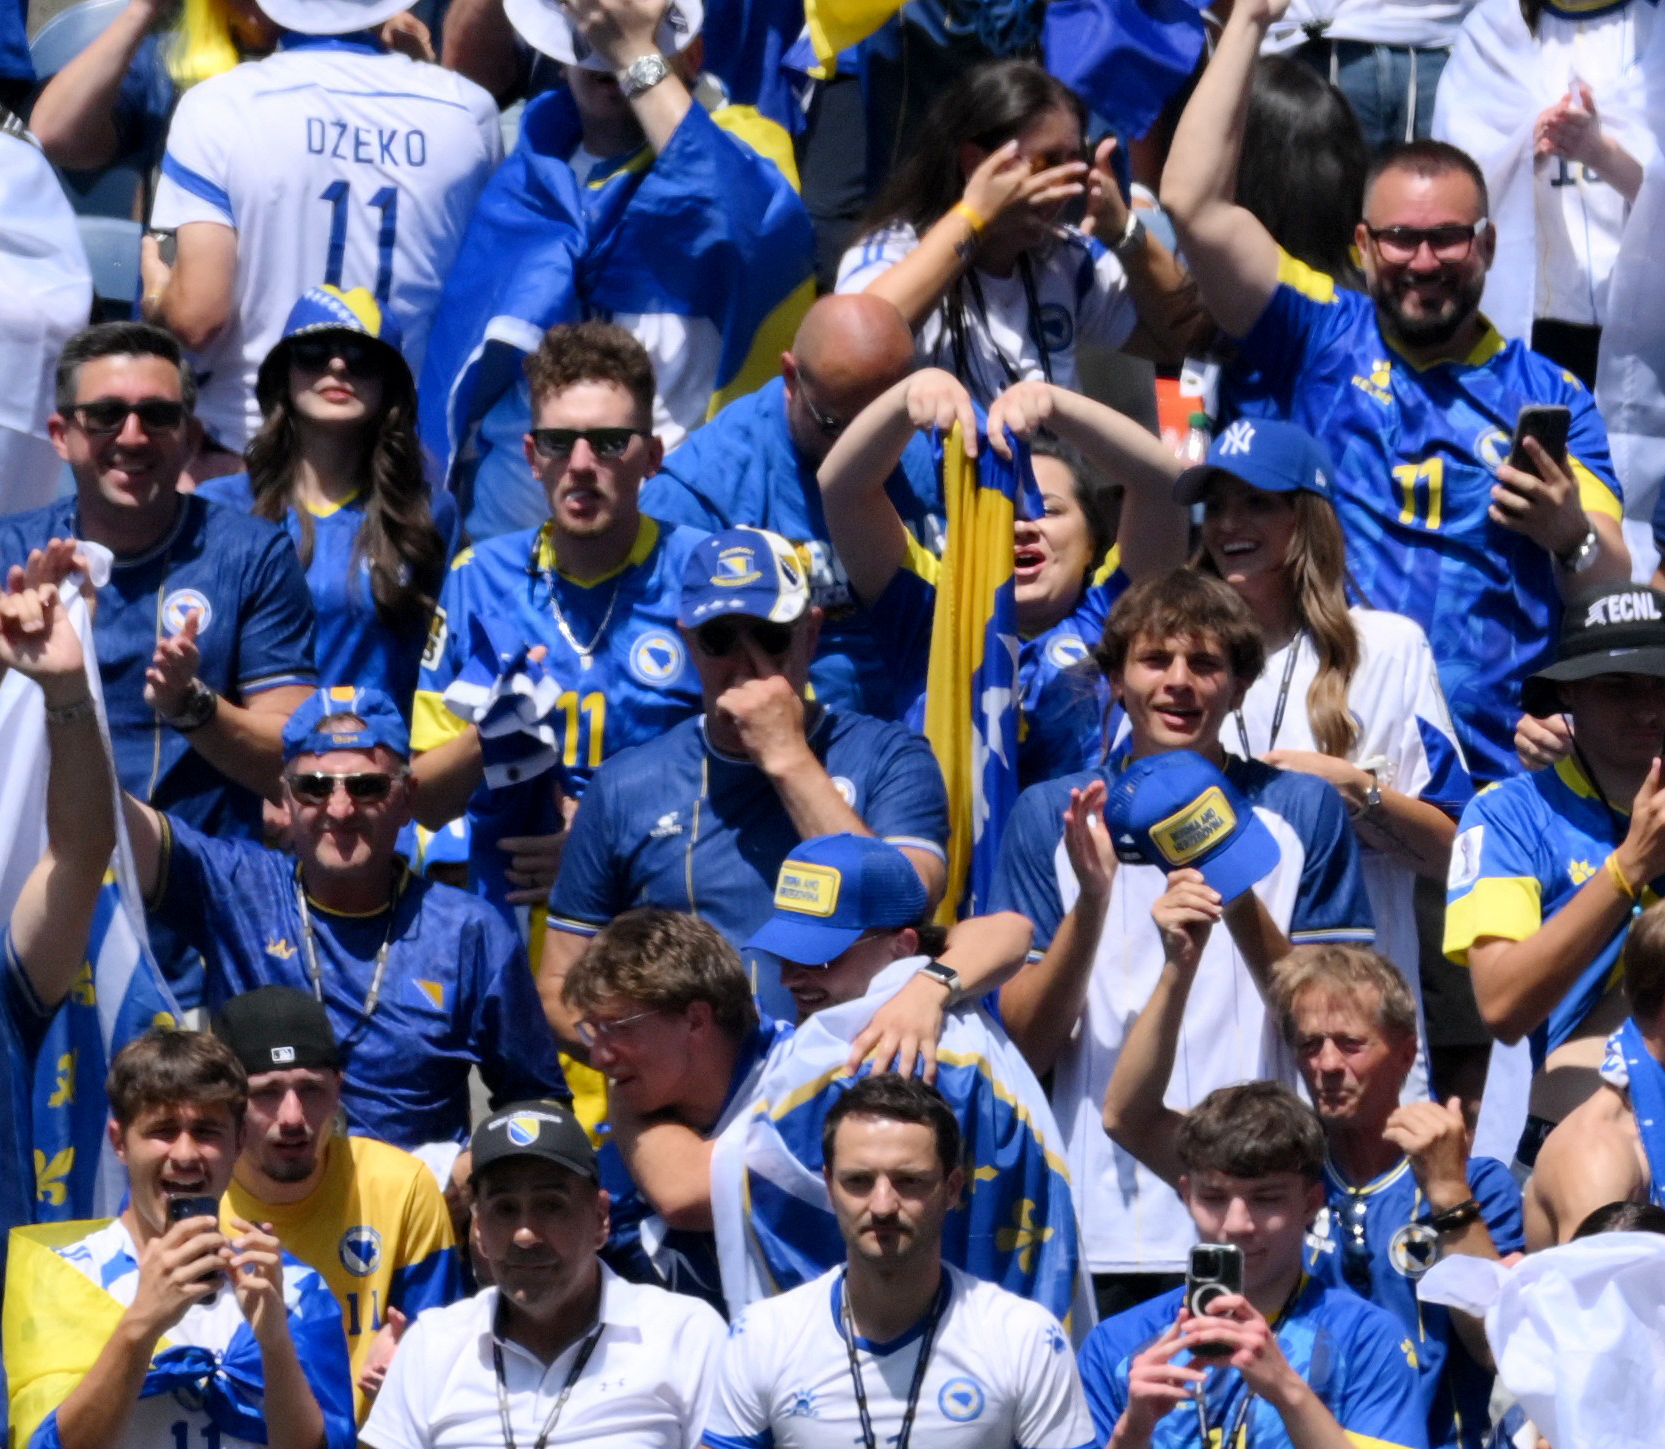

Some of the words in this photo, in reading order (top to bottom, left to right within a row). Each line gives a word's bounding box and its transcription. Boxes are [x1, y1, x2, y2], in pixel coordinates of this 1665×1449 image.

[318, 180, 399, 300] 11
[1391, 457, 1443, 531] 11
[1607, 591, 1662, 624] ECNL
[555, 691, 606, 767] 11
